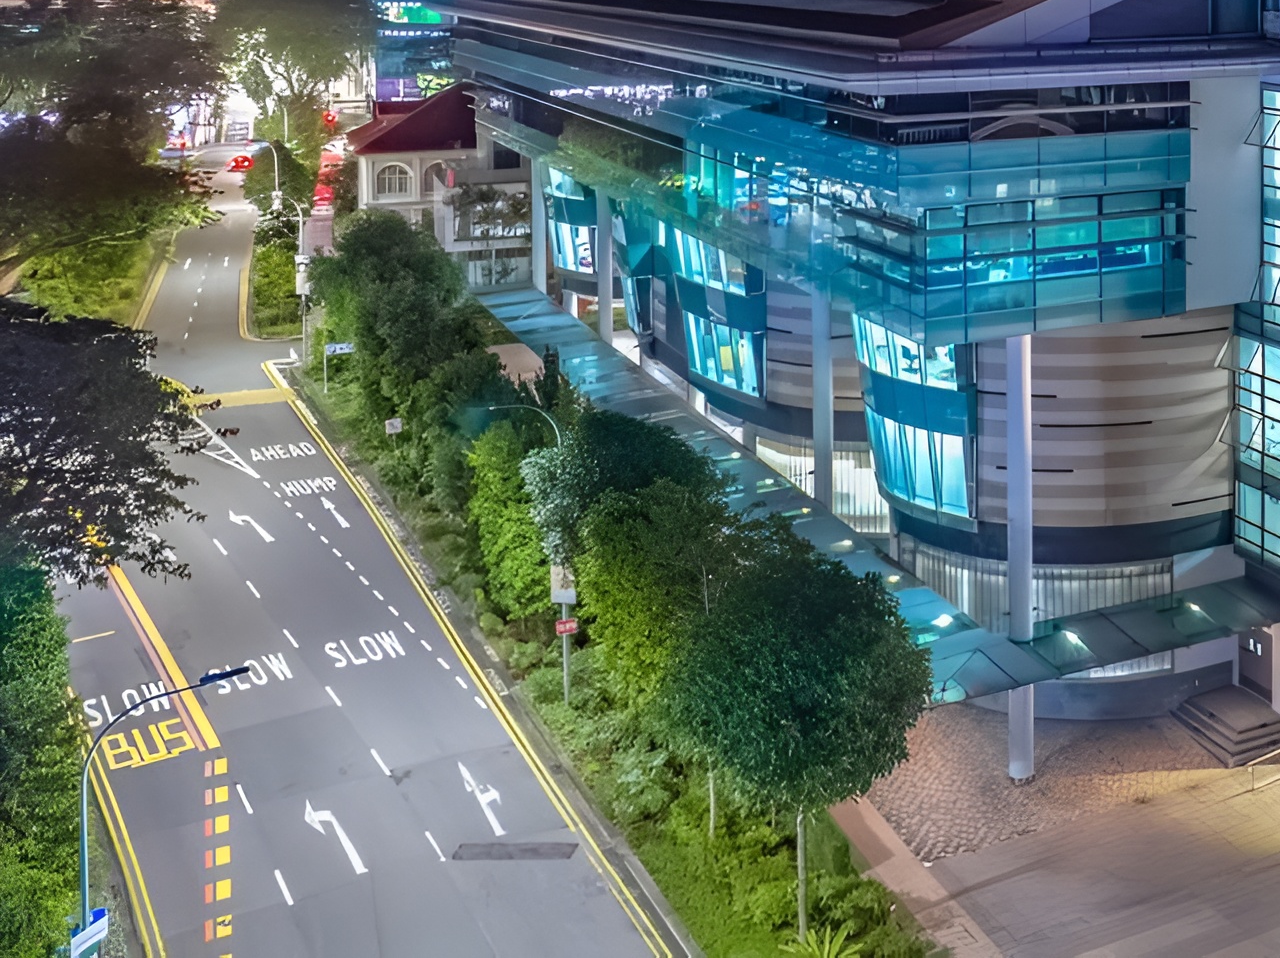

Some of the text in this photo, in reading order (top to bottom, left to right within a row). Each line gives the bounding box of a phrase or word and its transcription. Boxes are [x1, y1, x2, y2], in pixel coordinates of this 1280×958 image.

[250, 442, 317, 462] AHEAD
[280, 477, 336, 497] HUMP
[324, 630, 406, 668] SLOW
[206, 652, 294, 694] SLOW
[83, 680, 171, 728] SLOW
[101, 717, 195, 770] BUS
